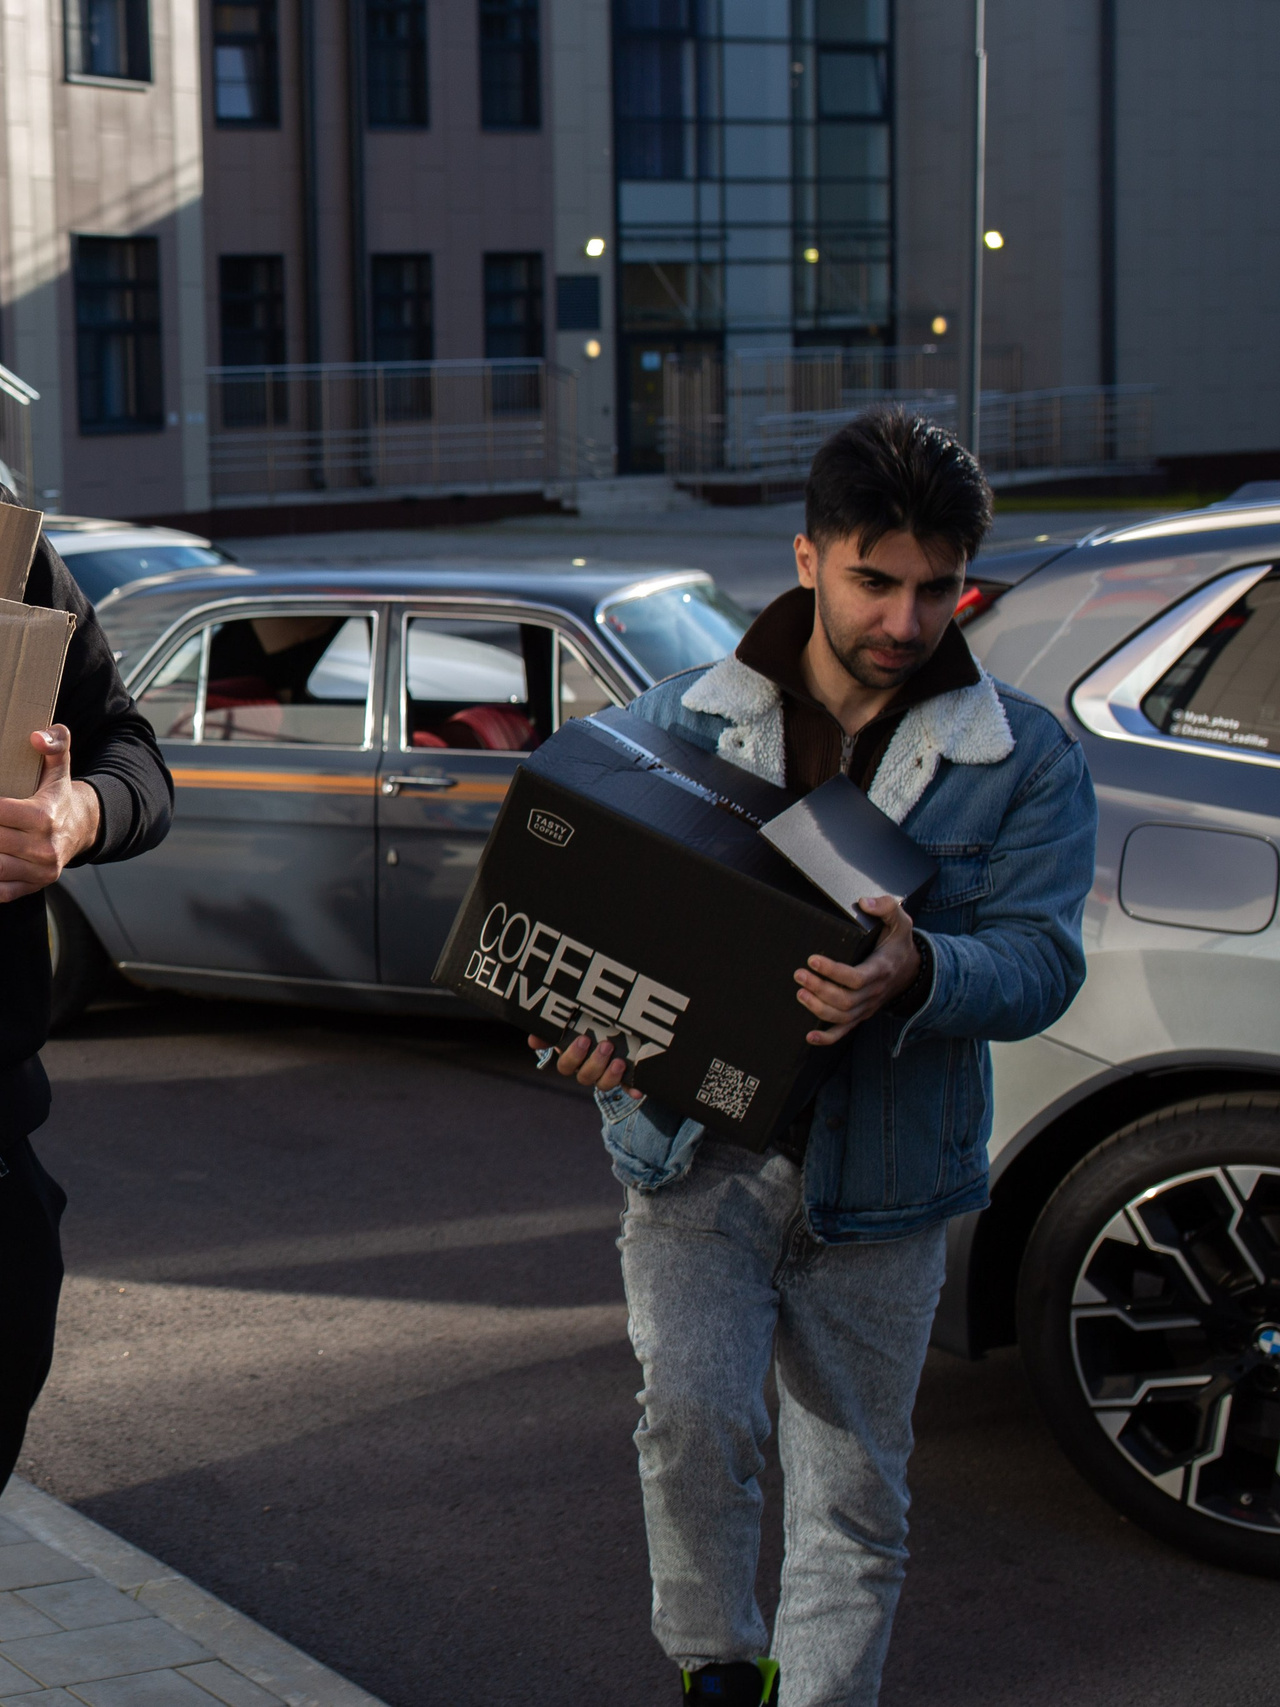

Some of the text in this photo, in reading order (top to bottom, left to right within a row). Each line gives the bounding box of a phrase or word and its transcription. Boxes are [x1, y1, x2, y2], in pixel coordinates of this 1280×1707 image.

[532, 823, 563, 842] COFFEE
[535, 813, 567, 835] TASTY
[464, 950, 668, 1067] DELIVERY
[480, 902, 690, 1047] COFFEE
